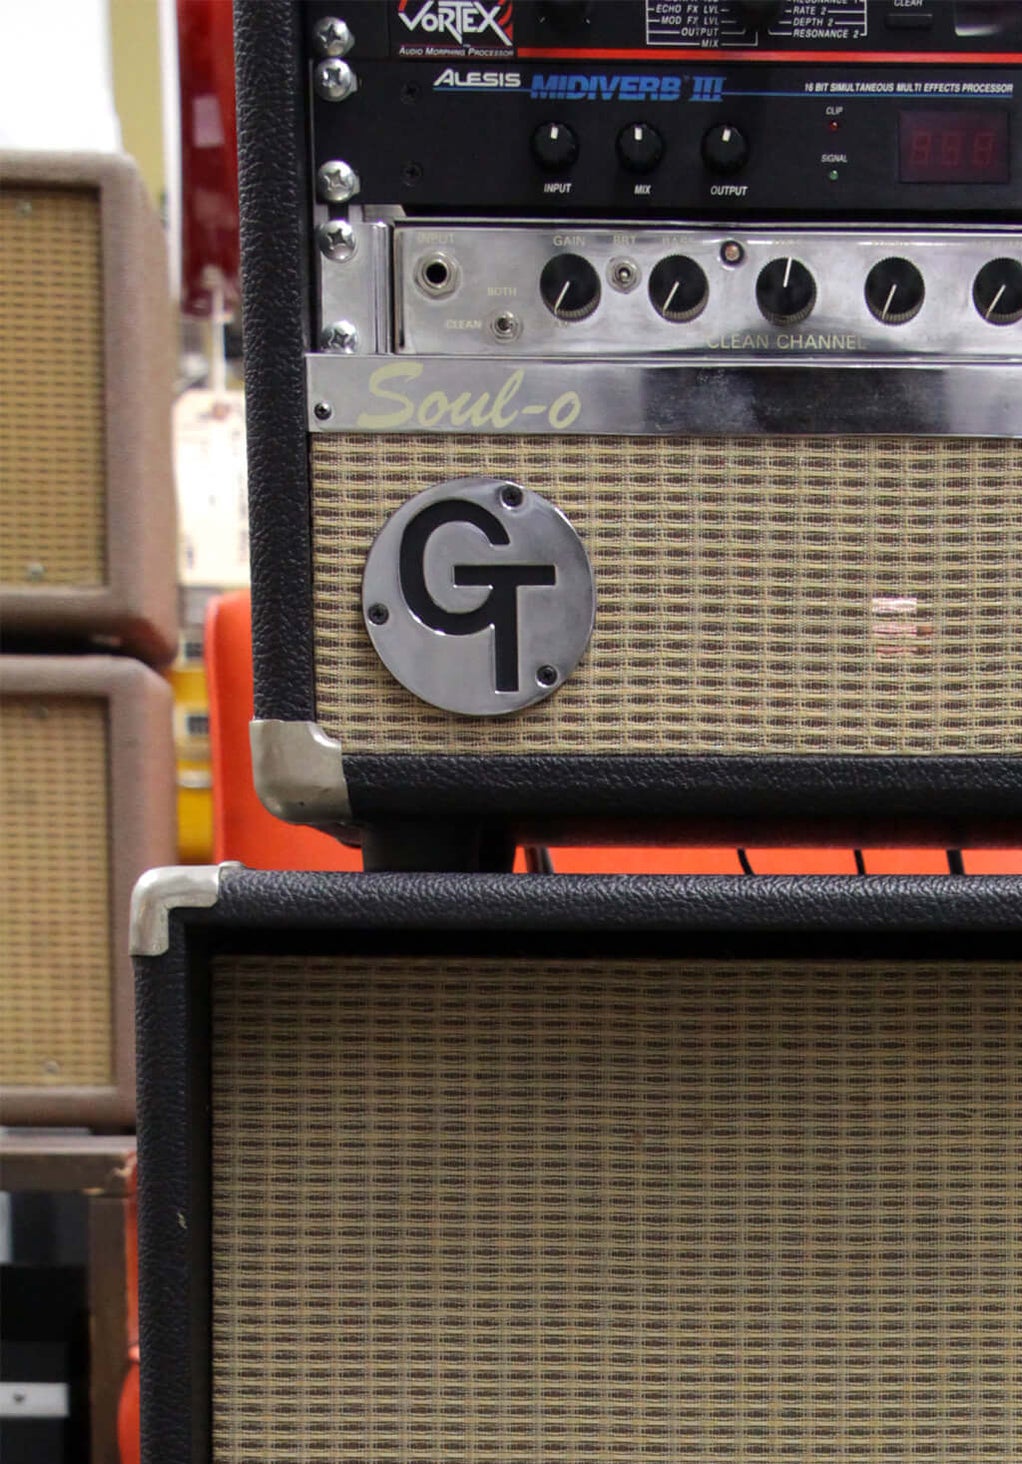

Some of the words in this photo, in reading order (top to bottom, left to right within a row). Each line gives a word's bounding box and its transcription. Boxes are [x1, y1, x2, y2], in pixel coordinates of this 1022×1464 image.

[656, 4, 682, 14] ECHO
[686, 4, 698, 14] FX
[703, 4, 719, 14] LVL
[793, 6, 816, 15] RATE
[820, 7, 827, 15] 2
[398, 0, 513, 46] VORTEX
[661, 16, 682, 25] MOD
[686, 16, 699, 25] FX
[703, 16, 720, 25] LVL
[793, 17, 823, 27] DEPTH
[827, 18, 834, 27] 2
[681, 27, 719, 37] OUTPUT
[793, 29, 849, 39] RESONANCE
[853, 30, 860, 39] 2
[701, 39, 719, 48] MIX
[433, 68, 522, 88] ALESIS
[531, 74, 682, 103] MIDIVERB
[815, 82, 829, 92] BIT
[830, 82, 894, 93] SIMULTANEOUS
[896, 82, 922, 93] MULTI
[924, 83, 960, 94] EFFECTS
[962, 83, 1013, 94] PROCESSOR
[826, 106, 843, 115] CLIP
[821, 154, 847, 163] SIGNAL
[543, 183, 572, 193] INPUT
[634, 184, 651, 195] MIX
[710, 185, 748, 197] OUTPUT
[553, 235, 585, 247] GAIN
[447, 319, 482, 330] CLEAN
[707, 334, 770, 350] CLEAN
[776, 334, 868, 350] CHANNEL
[357, 361, 582, 429] Soul-o
[400, 498, 556, 692] GT
